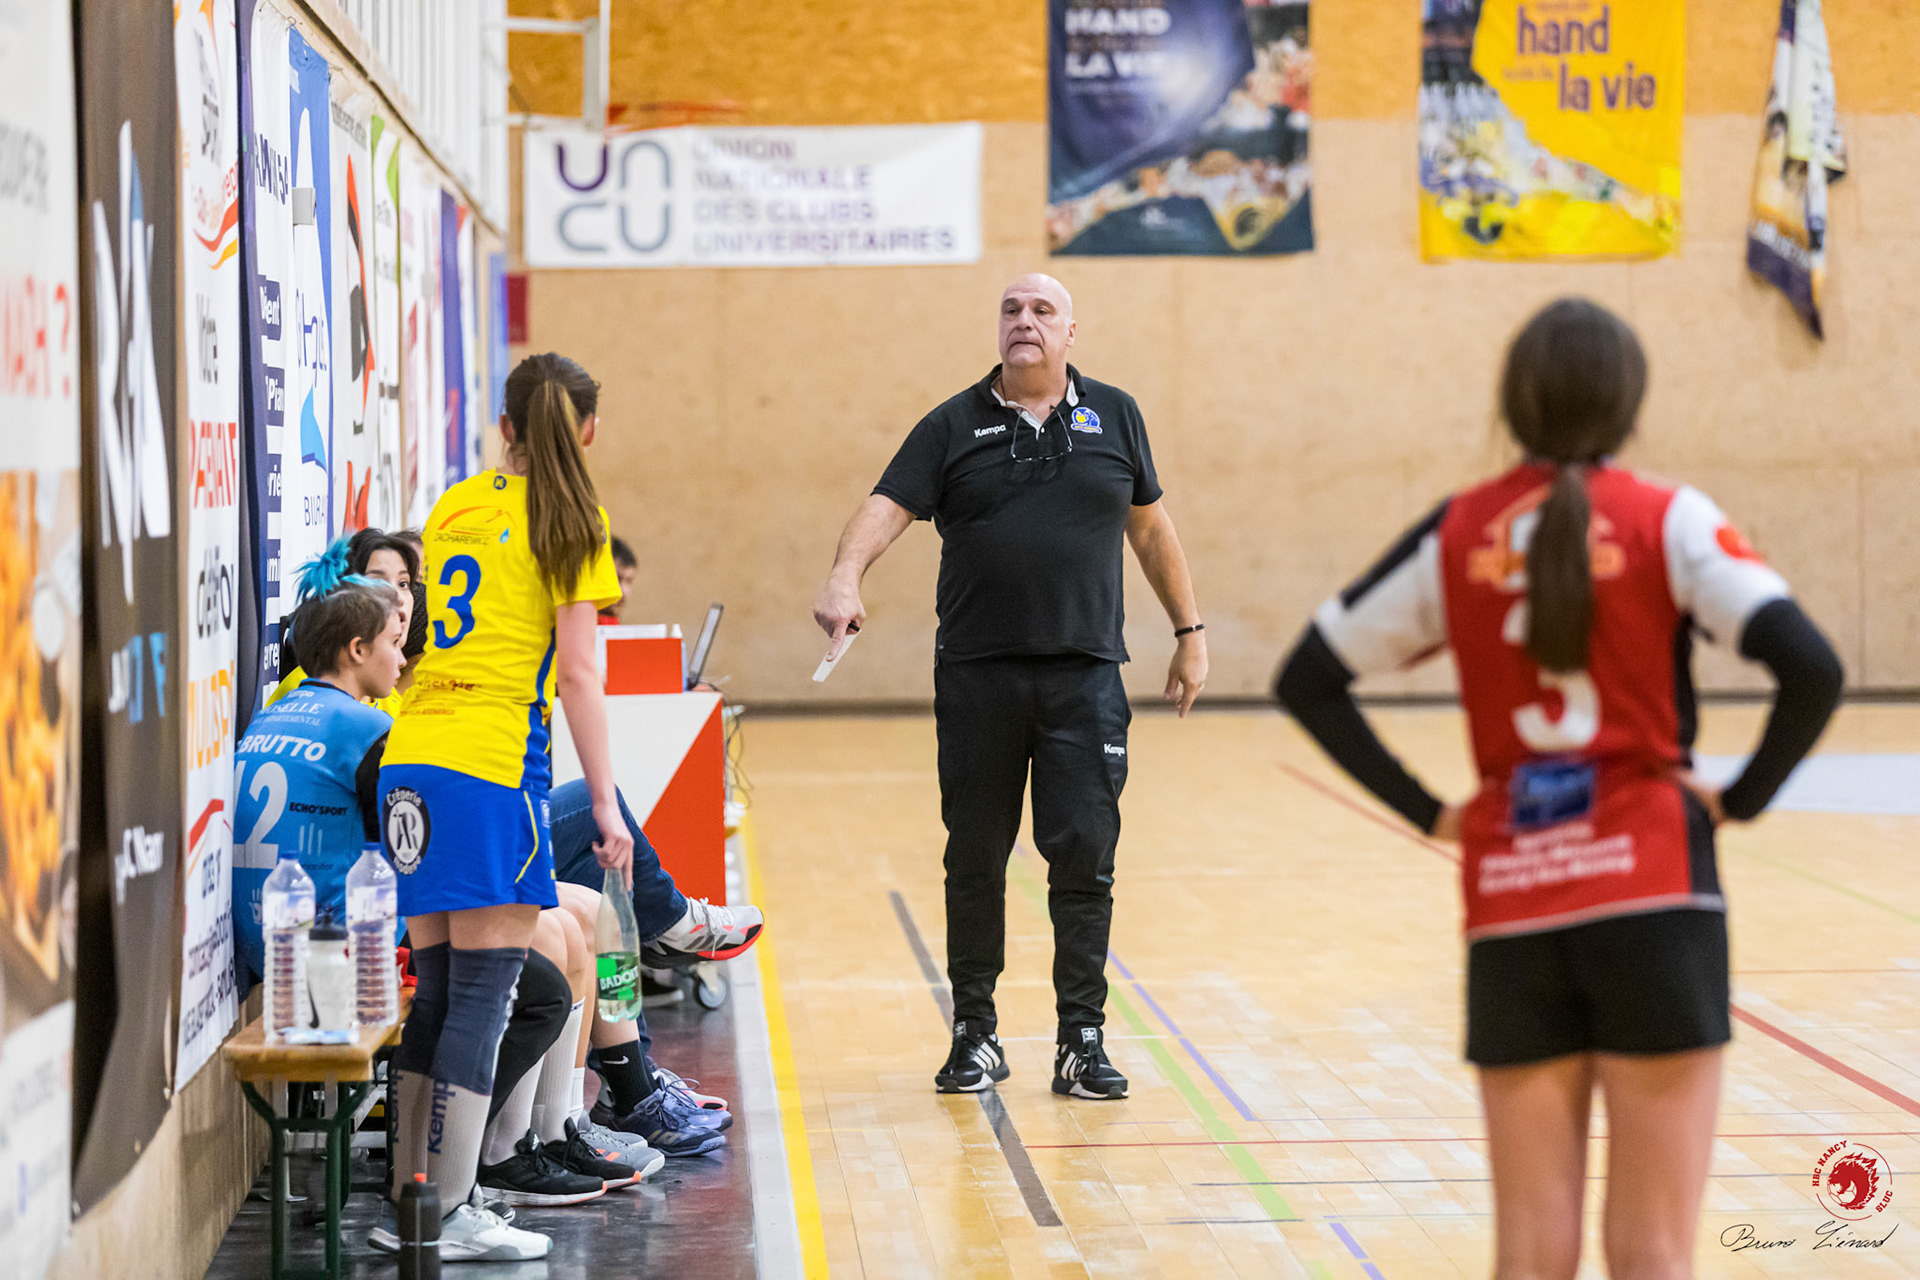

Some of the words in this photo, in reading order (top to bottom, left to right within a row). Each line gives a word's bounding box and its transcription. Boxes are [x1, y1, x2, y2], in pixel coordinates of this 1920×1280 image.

[1065, 8, 1171, 36] HAND
[1517, 5, 1610, 56] hand
[1065, 51, 1112, 79] LA
[1558, 61, 1592, 112] la
[1602, 60, 1657, 110] vie
[693, 137, 796, 164] UNION
[693, 164, 872, 191] NATIONALE
[693, 199, 757, 222] DES
[766, 198, 875, 223] CLUBS
[693, 226, 957, 253] UNIVERSITAIRES
[974, 424, 1006, 438] Kempa
[432, 554, 482, 650] 3
[239, 734, 327, 762] BRUTTO
[289, 801, 348, 816] ECHO'SPORT
